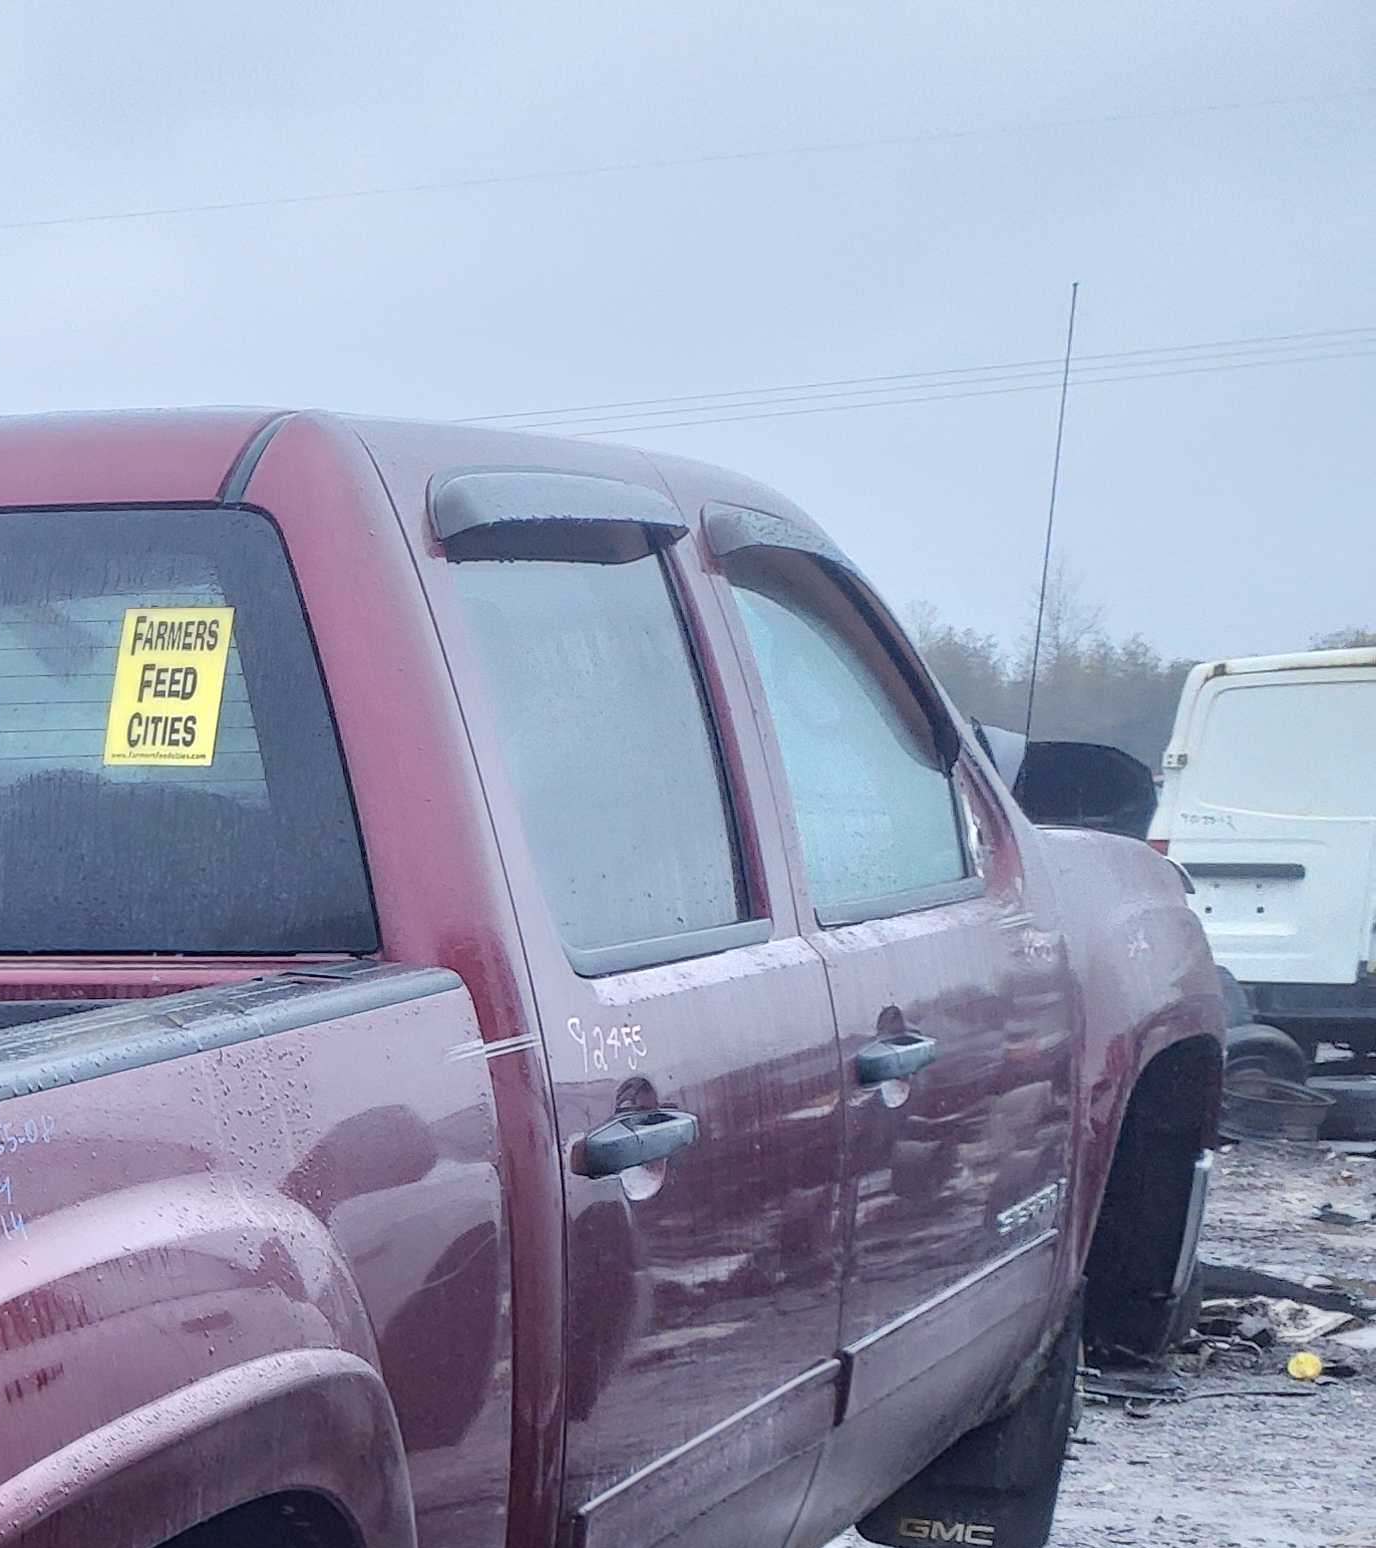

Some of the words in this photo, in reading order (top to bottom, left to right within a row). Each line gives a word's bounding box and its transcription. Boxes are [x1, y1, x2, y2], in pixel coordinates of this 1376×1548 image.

[130, 615, 220, 657] FARMERS
[136, 663, 199, 703] FEED
[126, 711, 198, 748] CITIES
[899, 1517, 996, 1547] GMC
